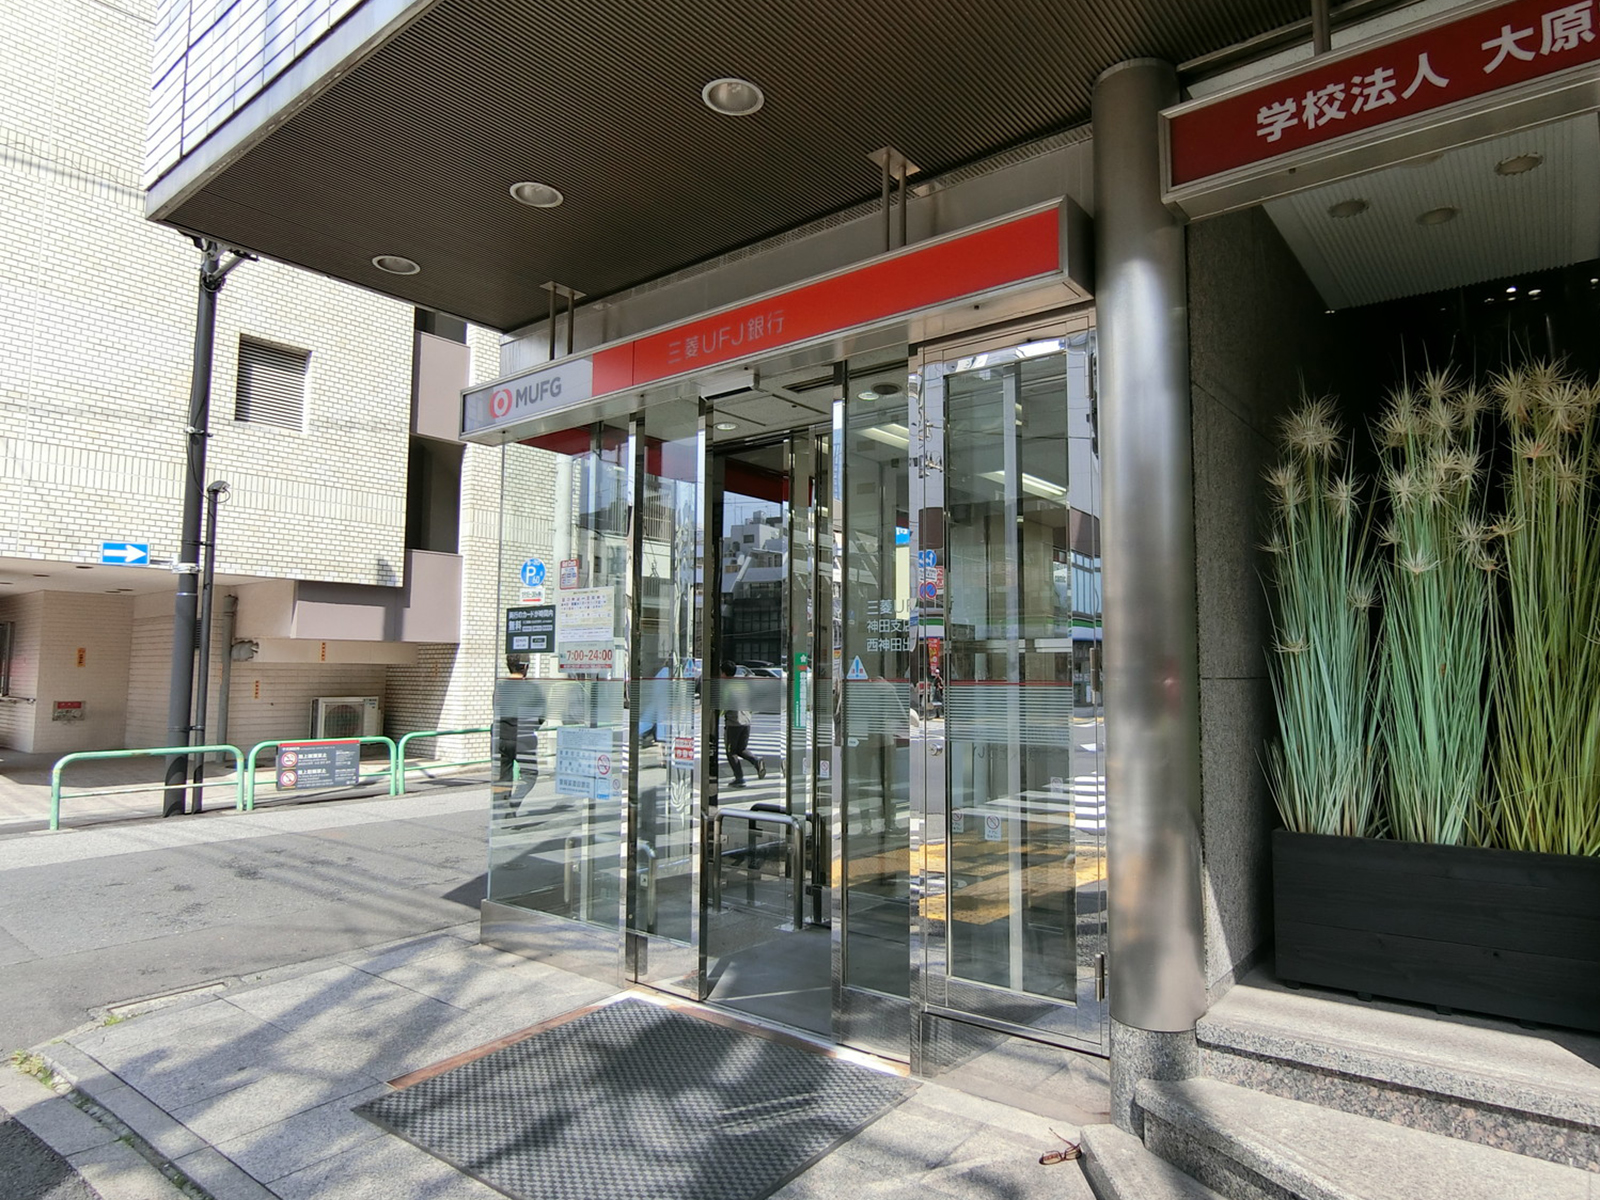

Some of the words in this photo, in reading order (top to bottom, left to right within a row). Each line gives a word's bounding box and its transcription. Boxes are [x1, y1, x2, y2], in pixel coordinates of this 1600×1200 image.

[1256, 52, 1450, 143] 学校法人
[1481, 0, 1597, 74] 大原
[668, 310, 785, 364] 三菱UFJ銀行
[515, 376, 562, 408] MUFG
[526, 566, 536, 584] P
